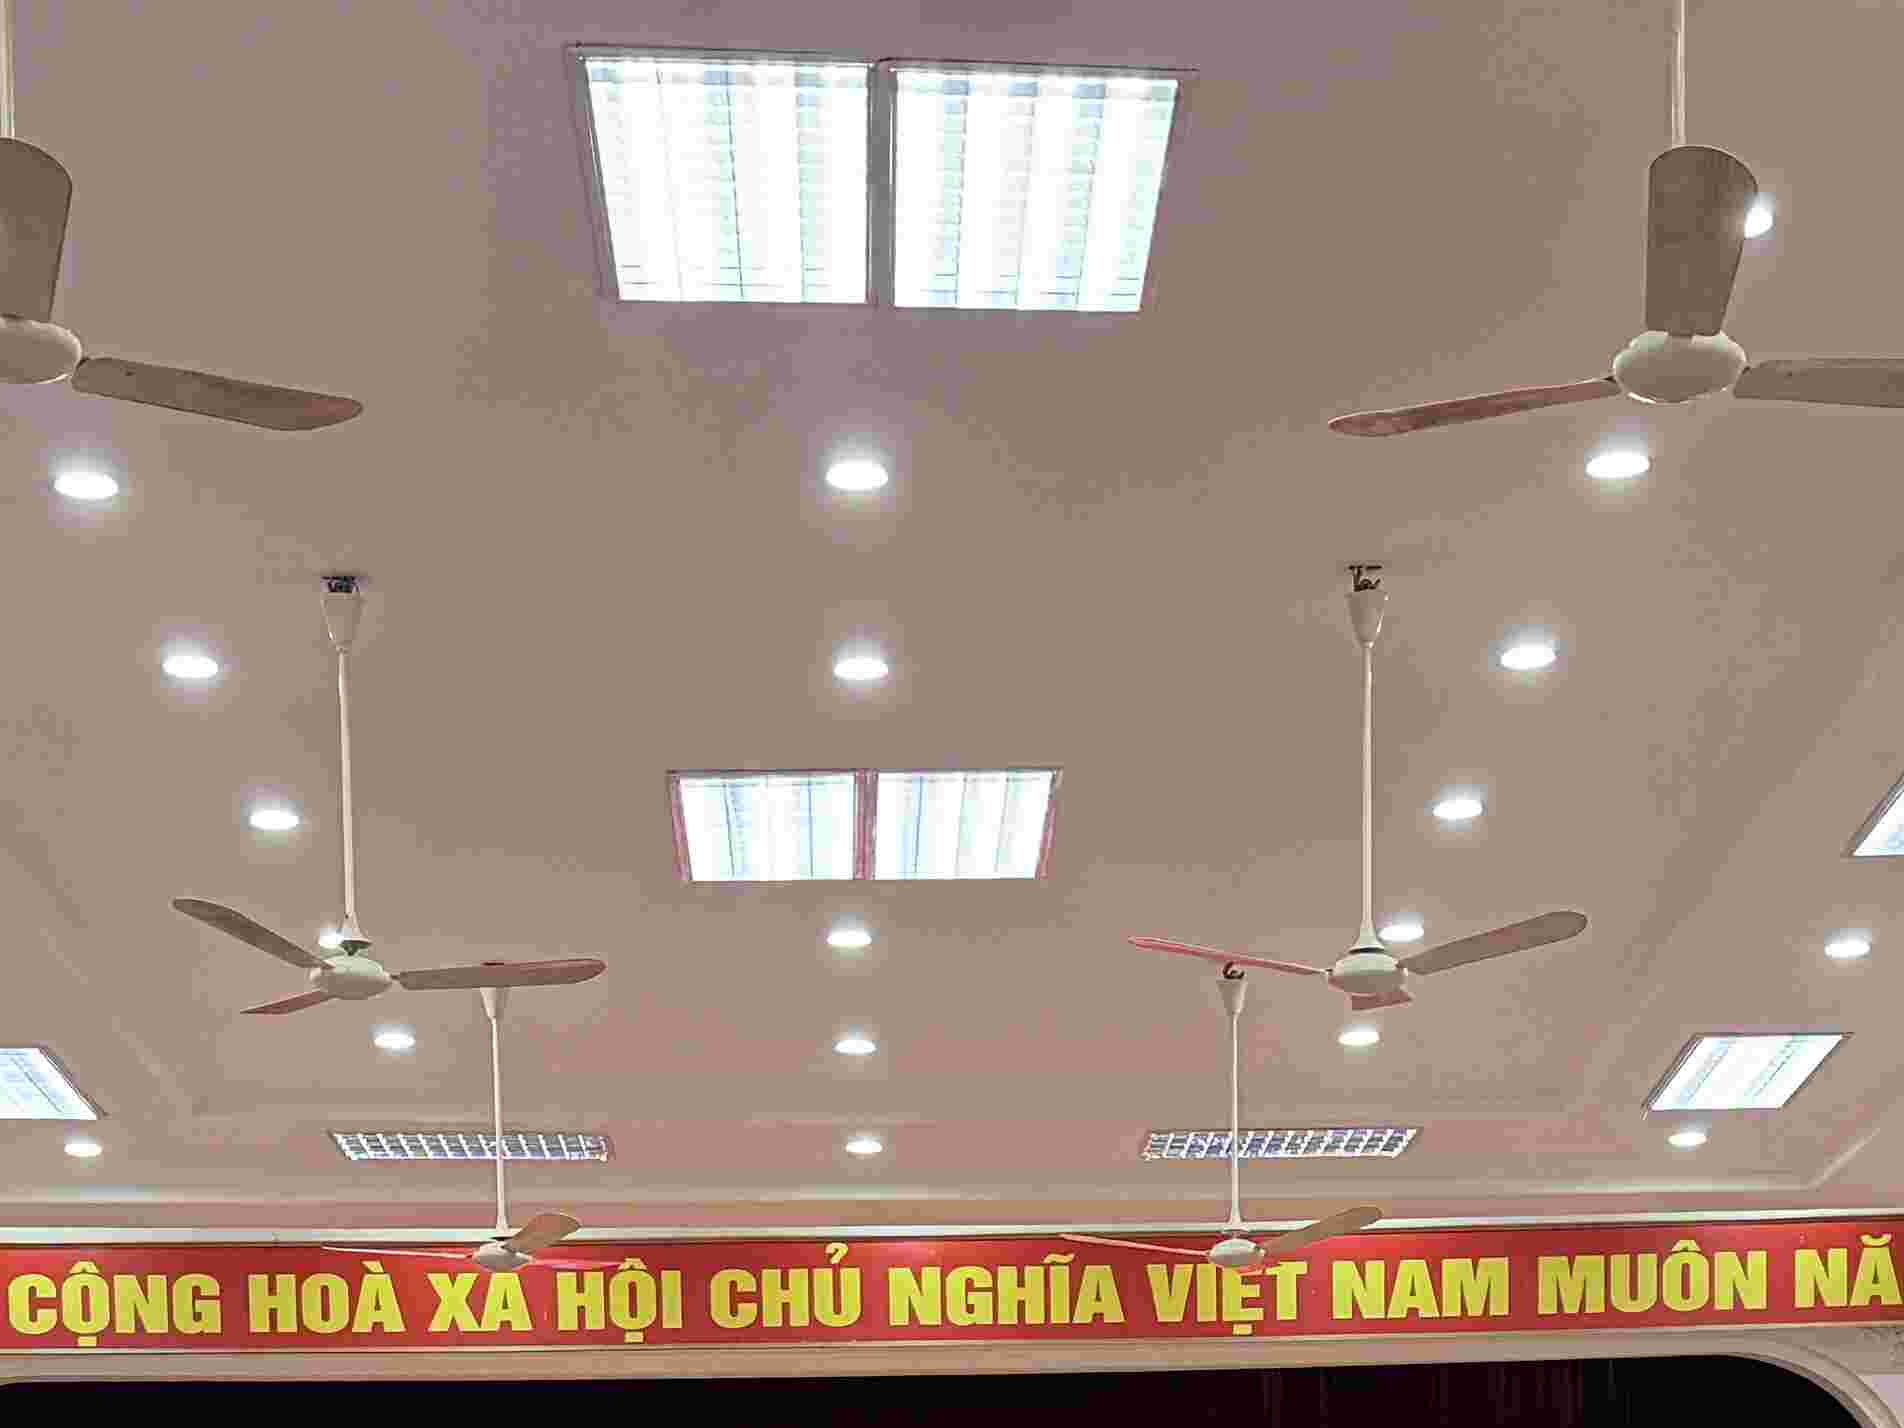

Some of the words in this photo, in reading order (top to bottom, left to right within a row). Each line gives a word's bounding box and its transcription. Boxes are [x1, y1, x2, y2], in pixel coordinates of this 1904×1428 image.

[7, 1260, 222, 1347] CỘNG
[248, 1260, 405, 1334] HOÀ
[556, 1257, 683, 1343] HỘI
[710, 1242, 862, 1329] CHỦ
[887, 1253, 1125, 1327] NGHĨA
[1332, 1257, 1510, 1320] NAM
[1537, 1239, 1767, 1315] MUÔN
